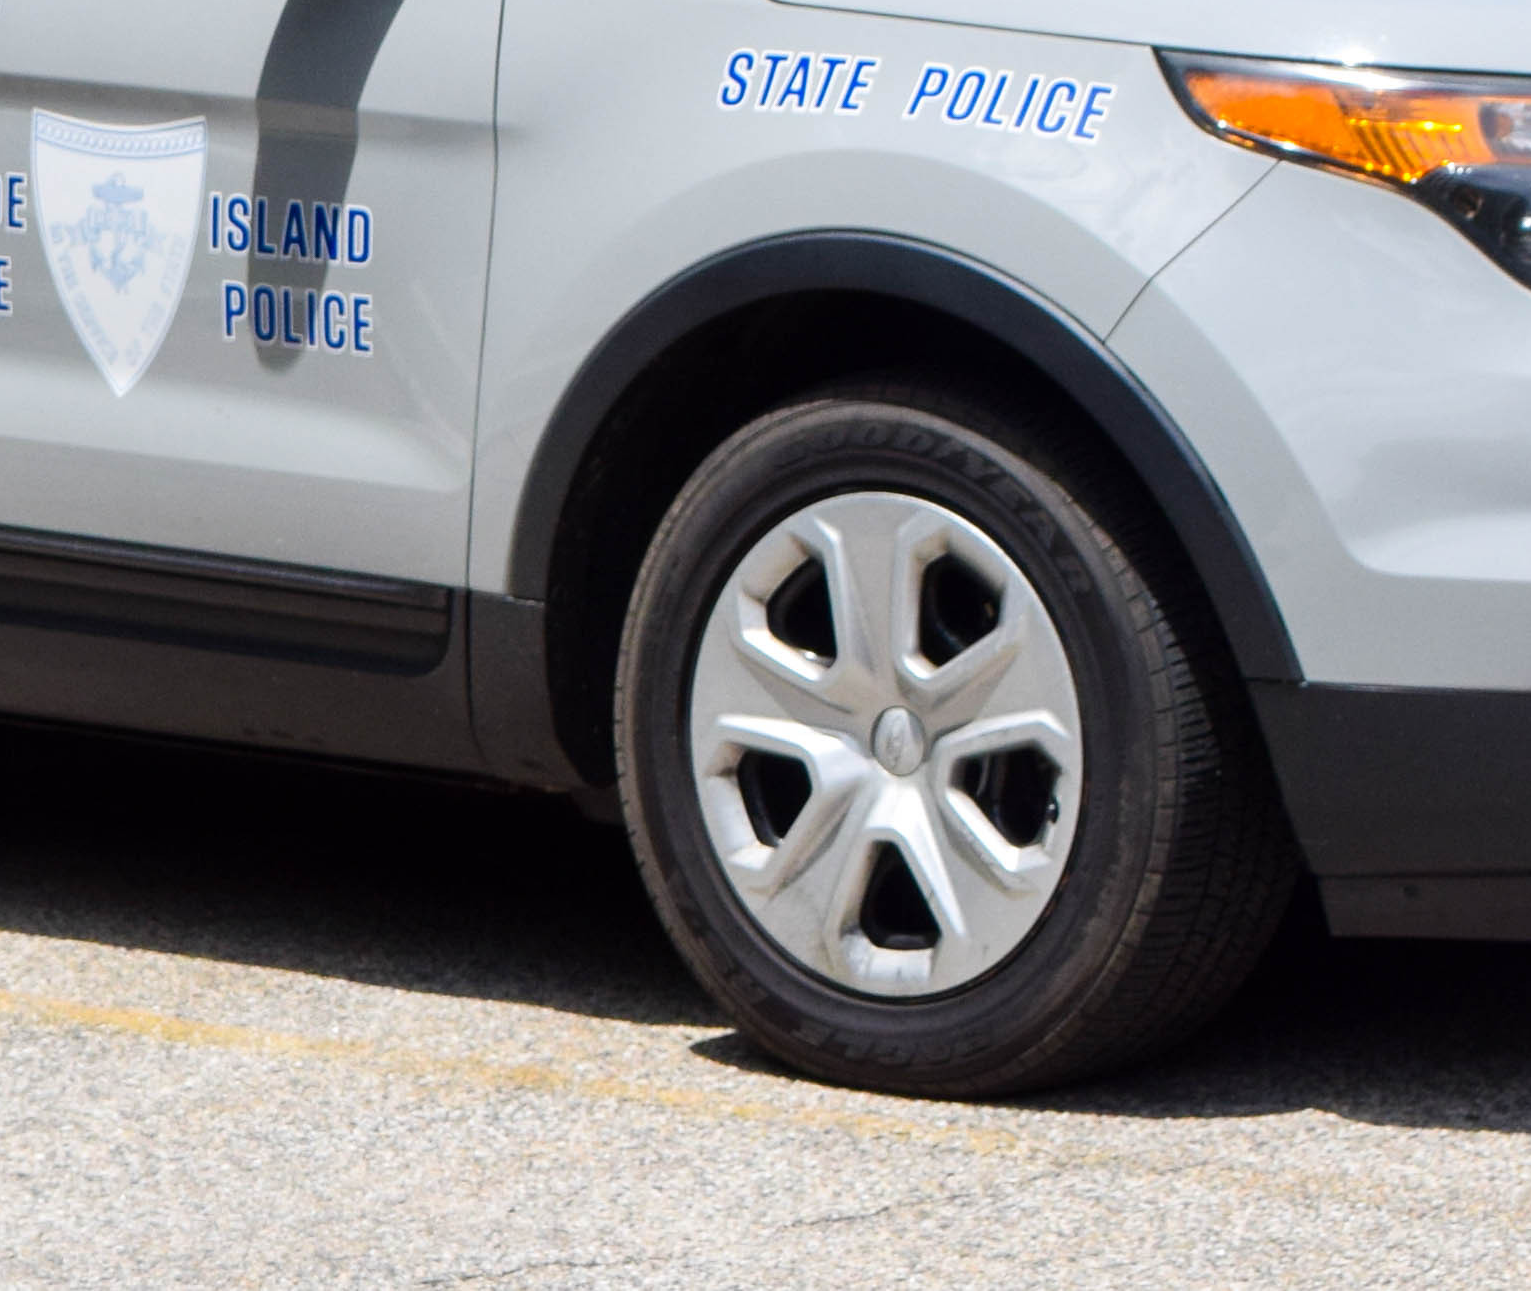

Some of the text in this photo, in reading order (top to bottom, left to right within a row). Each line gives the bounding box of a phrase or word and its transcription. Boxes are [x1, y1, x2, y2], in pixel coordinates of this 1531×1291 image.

[721, 52, 1112, 140] STATE POLICE
[210, 193, 372, 264] ISLAND
[224, 283, 372, 353] POLICE
